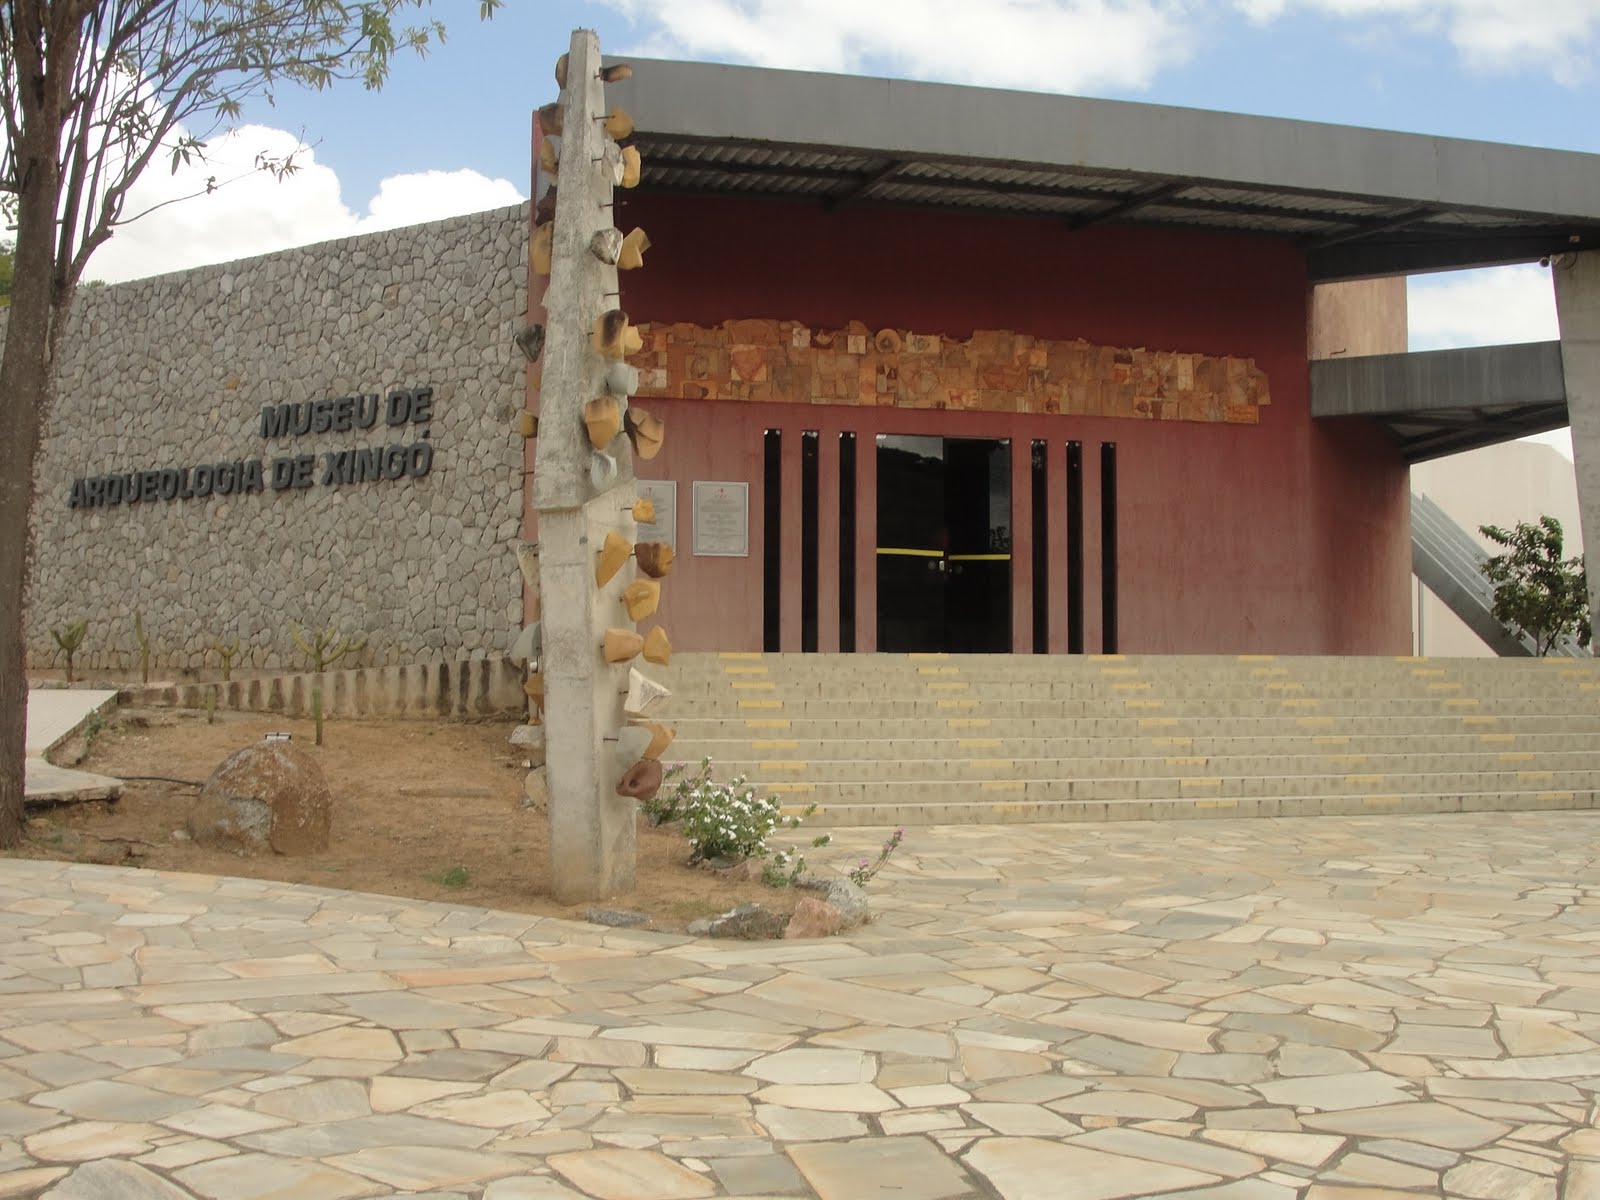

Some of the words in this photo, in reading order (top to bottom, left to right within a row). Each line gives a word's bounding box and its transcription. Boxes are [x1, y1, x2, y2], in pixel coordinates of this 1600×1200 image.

[260, 394, 379, 438] MUSEU
[385, 387, 433, 427] DE
[68, 460, 264, 509] ARQUEOLOGIA
[272, 454, 314, 491] DE
[321, 429, 433, 486] XINGÓ
